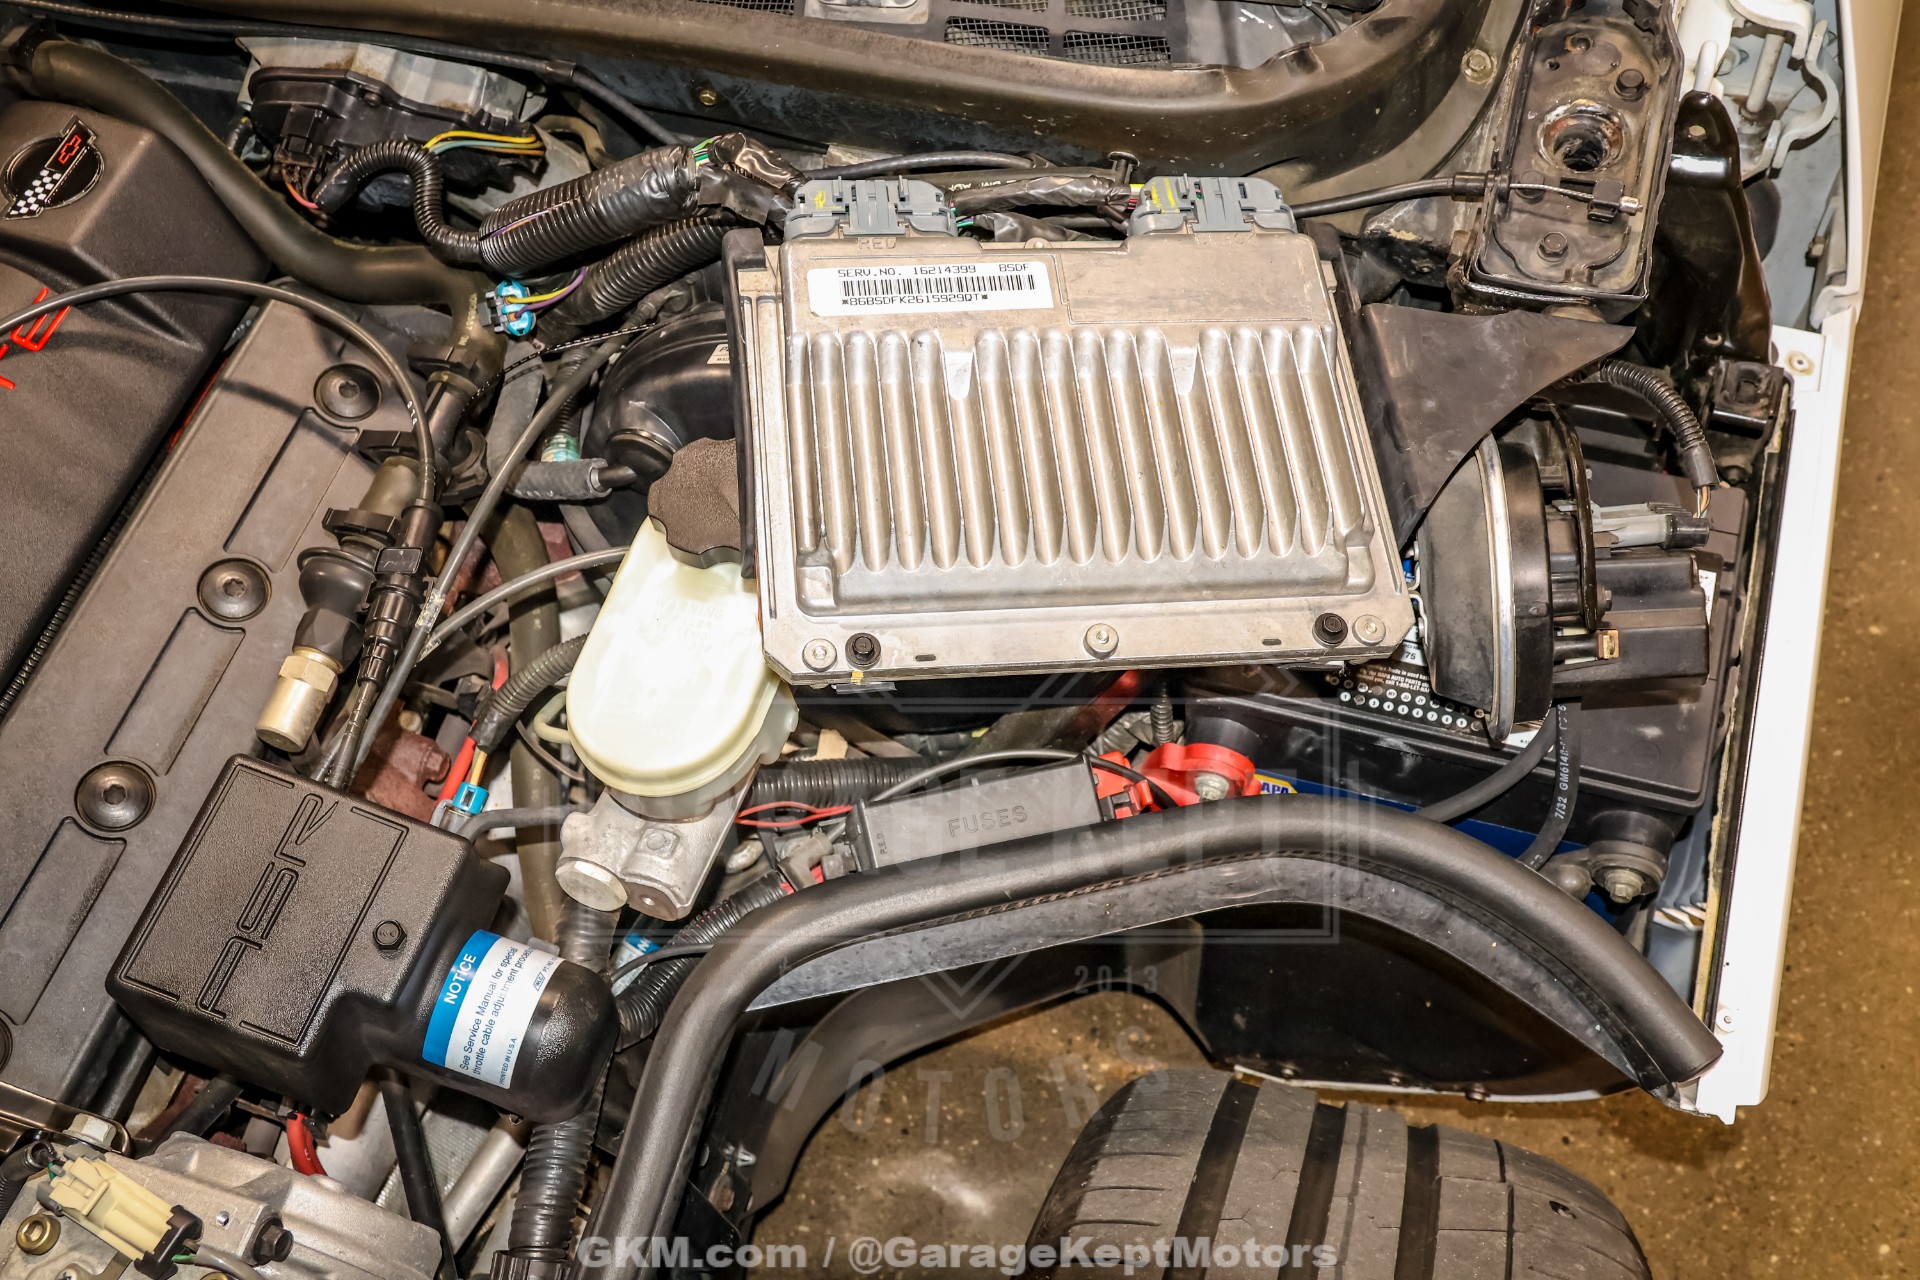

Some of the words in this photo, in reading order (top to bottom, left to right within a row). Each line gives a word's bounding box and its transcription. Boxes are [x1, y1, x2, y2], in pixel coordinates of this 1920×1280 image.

[858, 237, 897, 250] RED
[838, 267, 901, 278] SERV.NO.
[913, 265, 976, 275] 16214399
[1405, 652, 1417, 660] 75
[1391, 674, 1405, 682] AUTO
[1405, 677, 1422, 686] PARTS
[1261, 782, 1289, 794] APA
[1555, 797, 1568, 820] 7/32
[948, 805, 1028, 838] FUSES
[195, 793, 339, 1019] ASR
[500, 947, 518, 968] special
[443, 953, 477, 1005] NOTICE
[492, 968, 504, 980] for
[475, 981, 497, 1016] Manual
[472, 1047, 486, 1075] throttle
[481, 1019, 496, 1046] cable
[491, 968, 519, 1017] adjustment
[463, 1018, 482, 1054] Service
[460, 1055, 471, 1071] See
[499, 1062, 509, 1086] PRINTED
[506, 1037, 518, 1055] U.S.A.
